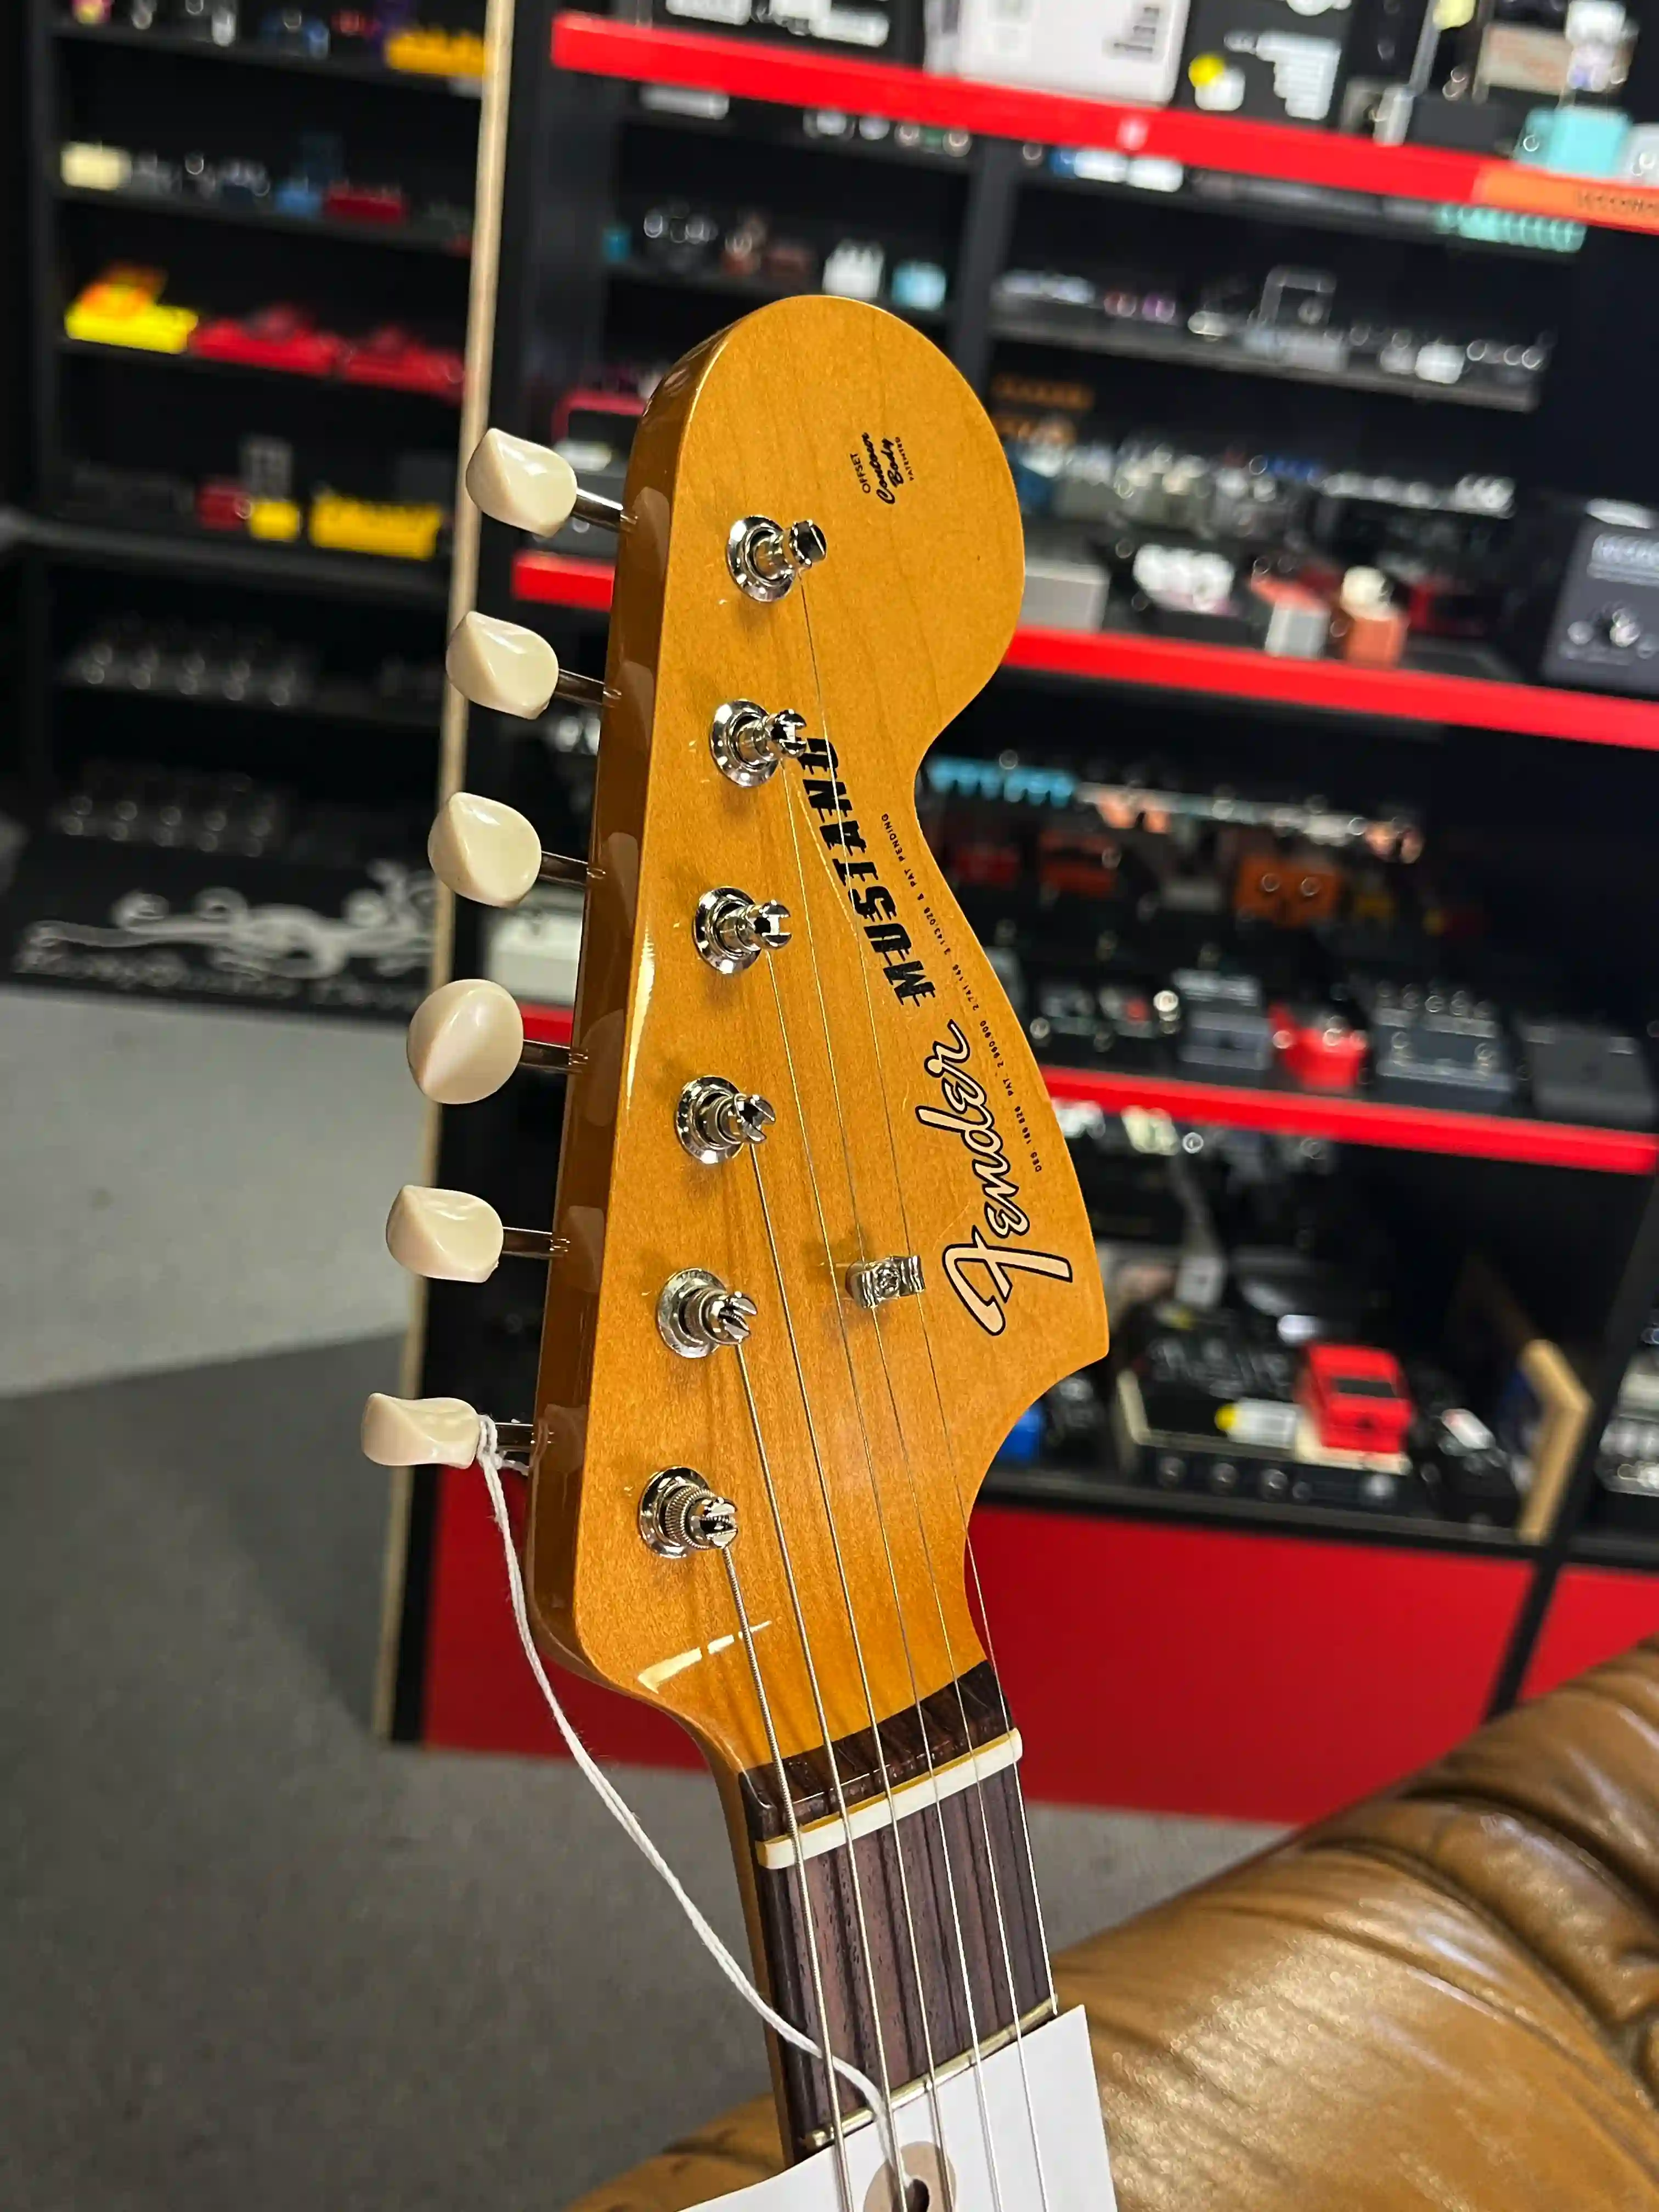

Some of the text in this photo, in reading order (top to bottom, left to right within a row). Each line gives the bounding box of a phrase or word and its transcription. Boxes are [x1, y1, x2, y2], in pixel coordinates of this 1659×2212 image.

[850, 453, 871, 493] OFFSET
[881, 438, 904, 488] Body
[895, 437, 914, 481] PATENTED
[881, 813, 906, 862] PENDING
[798, 737, 935, 1007] MUSTANG
[915, 1018, 1073, 1336] Fender
